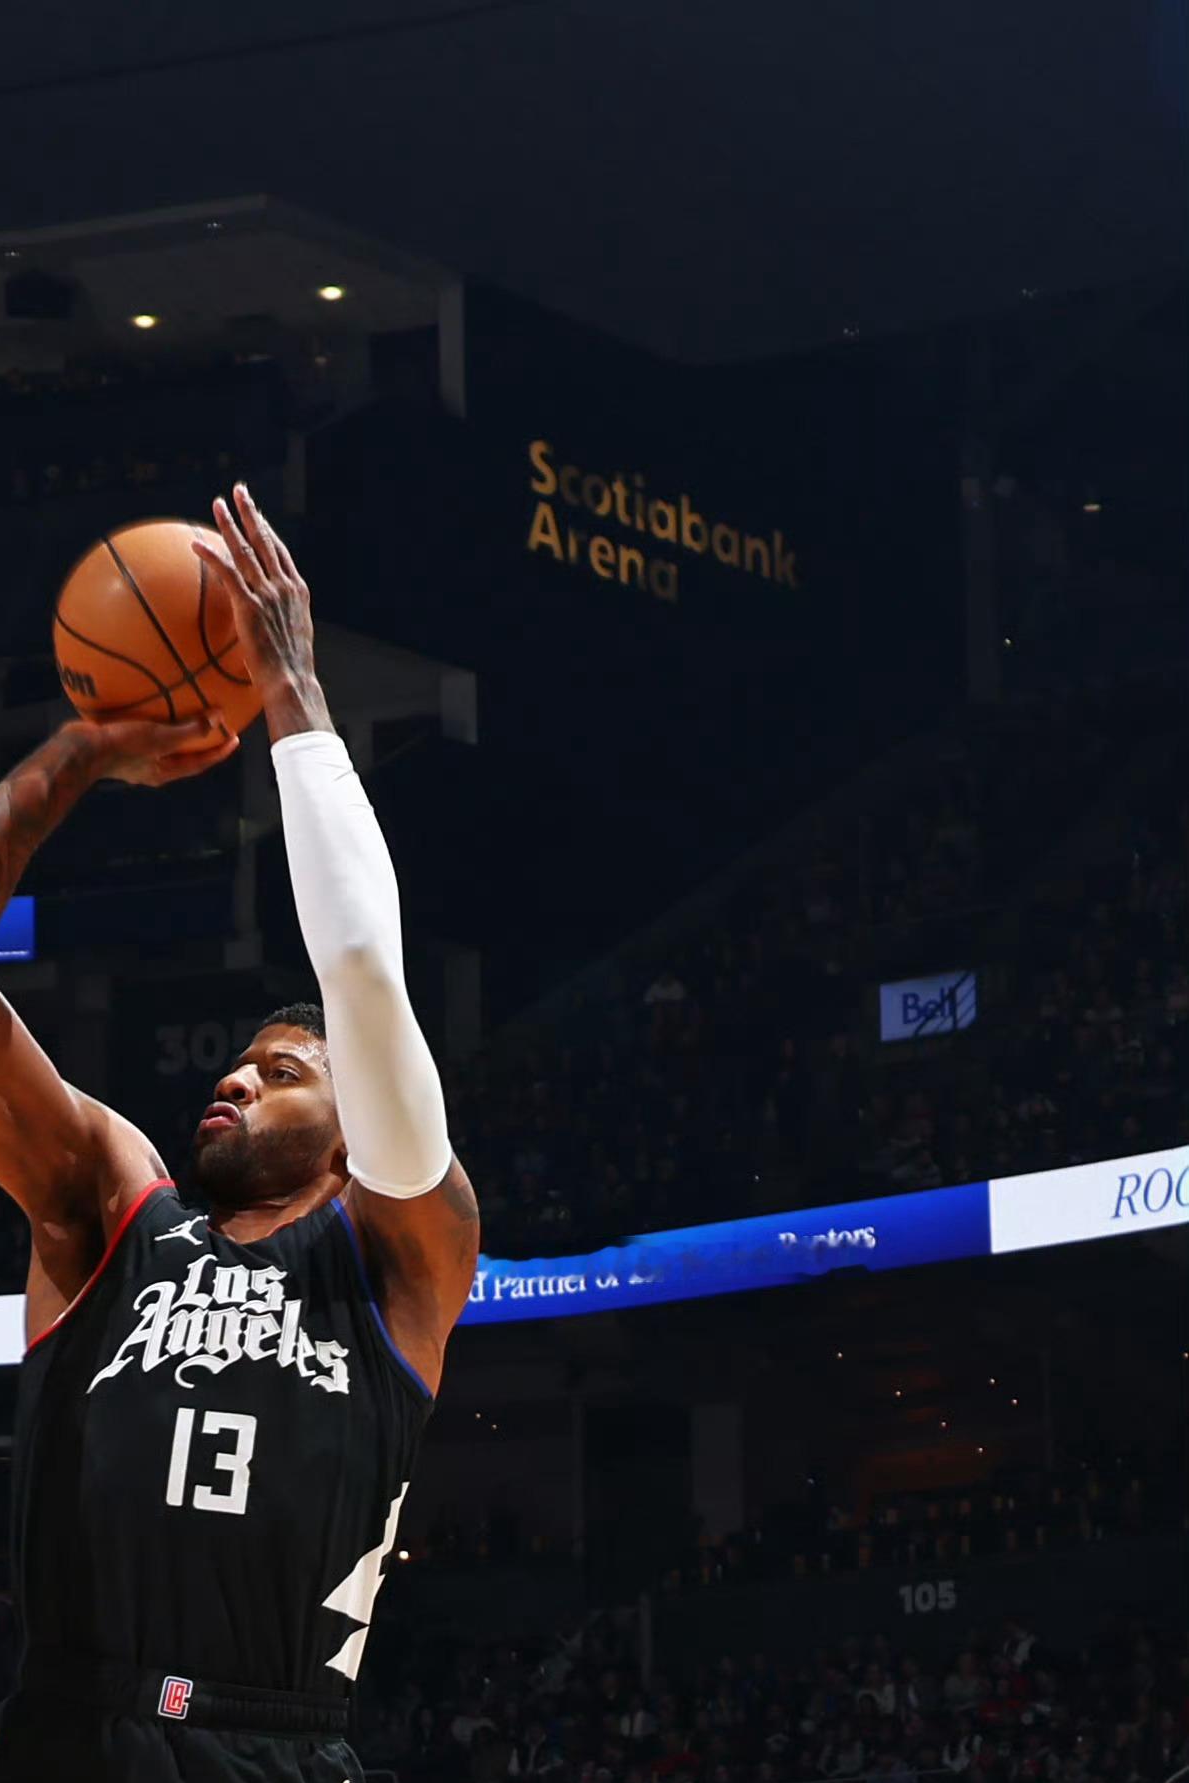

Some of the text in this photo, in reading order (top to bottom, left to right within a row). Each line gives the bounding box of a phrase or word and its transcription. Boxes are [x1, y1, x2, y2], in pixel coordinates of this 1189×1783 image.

[525, 499, 680, 603] Arena
[527, 438, 800, 591] Scotiabank
[902, 986, 956, 1024] Bell
[168, 1254, 288, 1312] Los
[86, 1281, 350, 1395] Angeles
[166, 1407, 257, 1515] 13
[898, 1579, 958, 1616] 105
